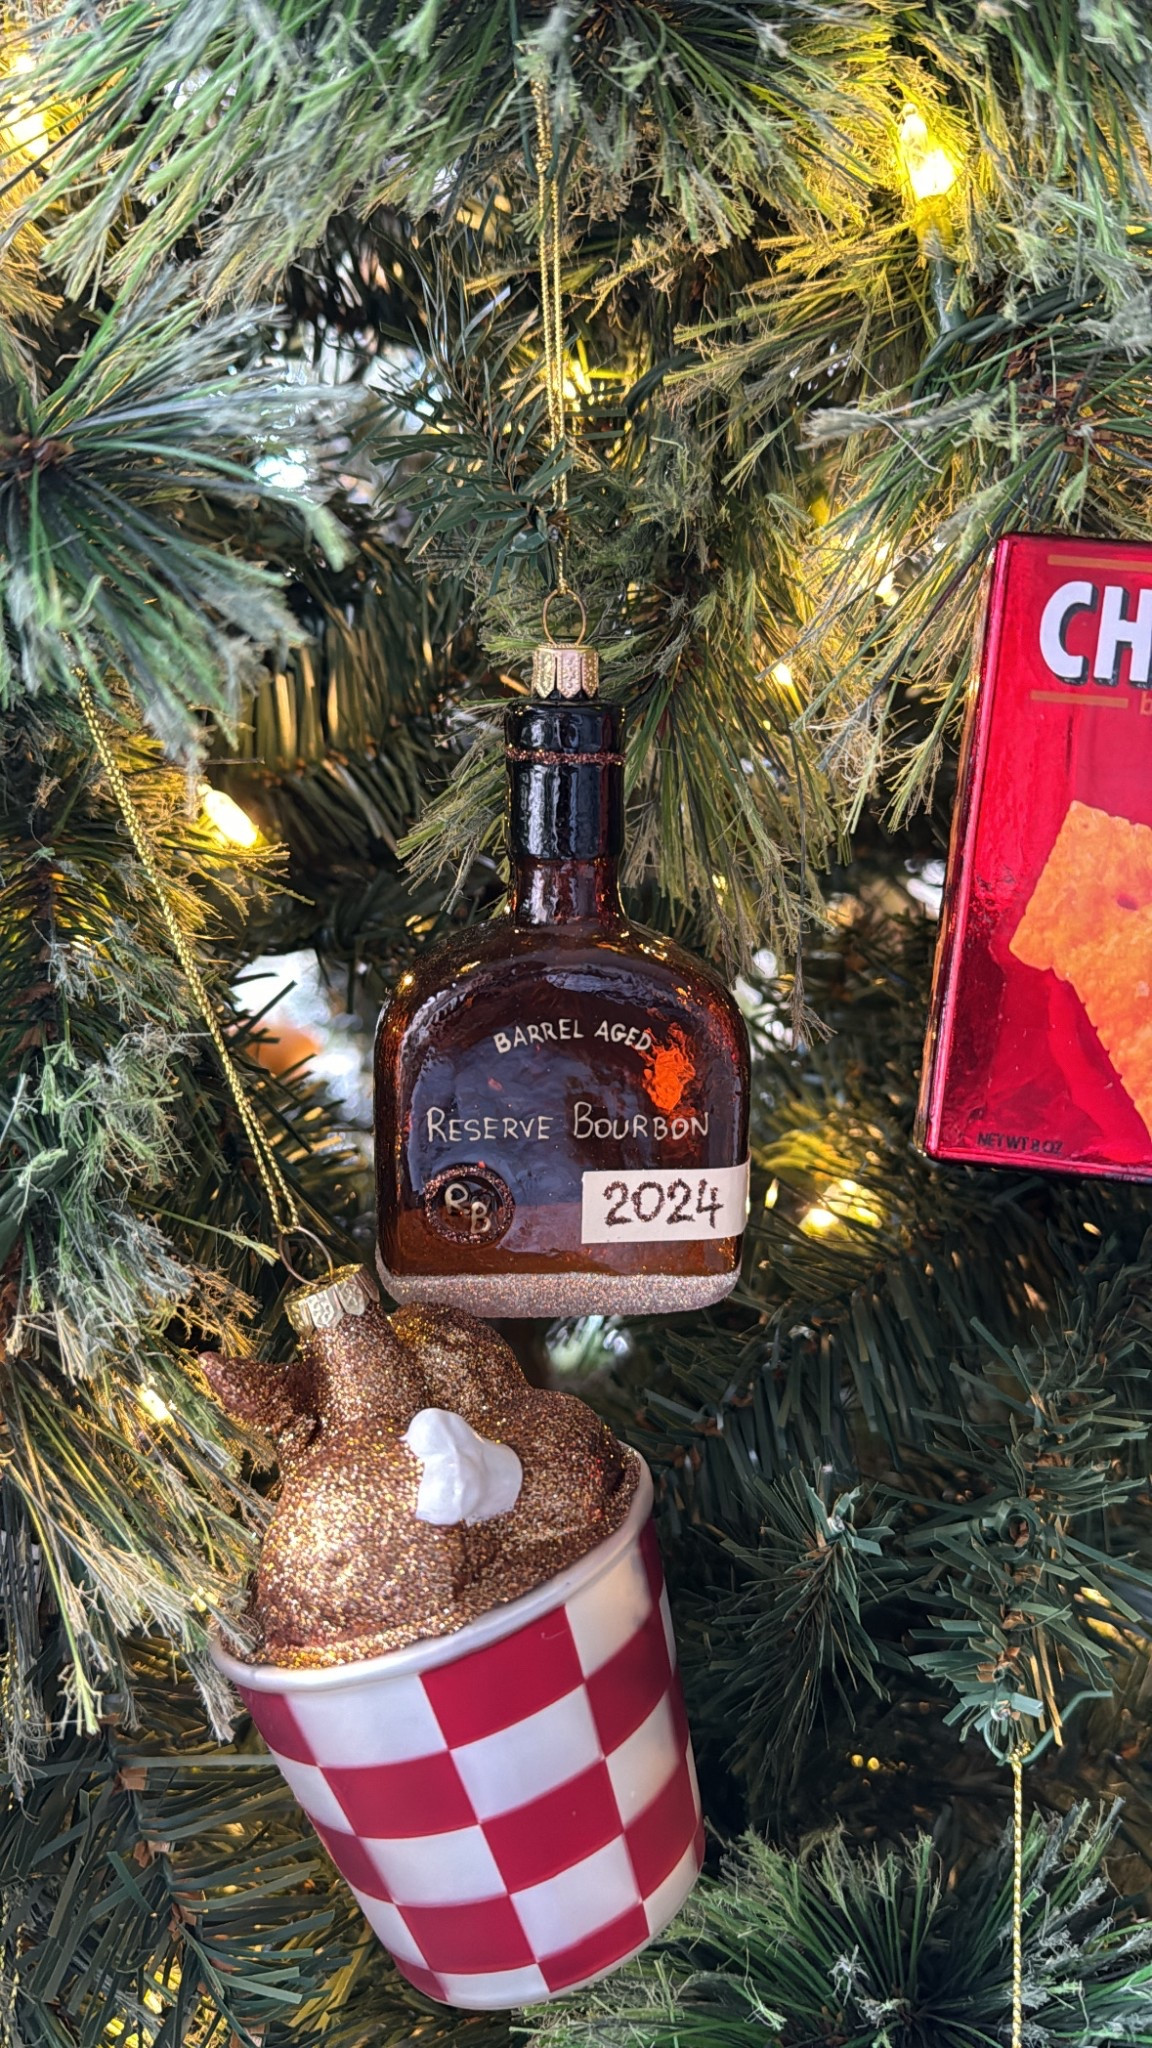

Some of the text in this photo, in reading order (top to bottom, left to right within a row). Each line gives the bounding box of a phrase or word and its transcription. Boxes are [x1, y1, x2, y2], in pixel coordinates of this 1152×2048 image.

[494, 1018, 652, 1054] BARREL AGED
[427, 1102, 709, 1143] RESERVE BOURBON
[977, 1131, 1004, 1148] NET
[1006, 1135, 1029, 1151] WT
[603, 1178, 724, 1229] 2024
